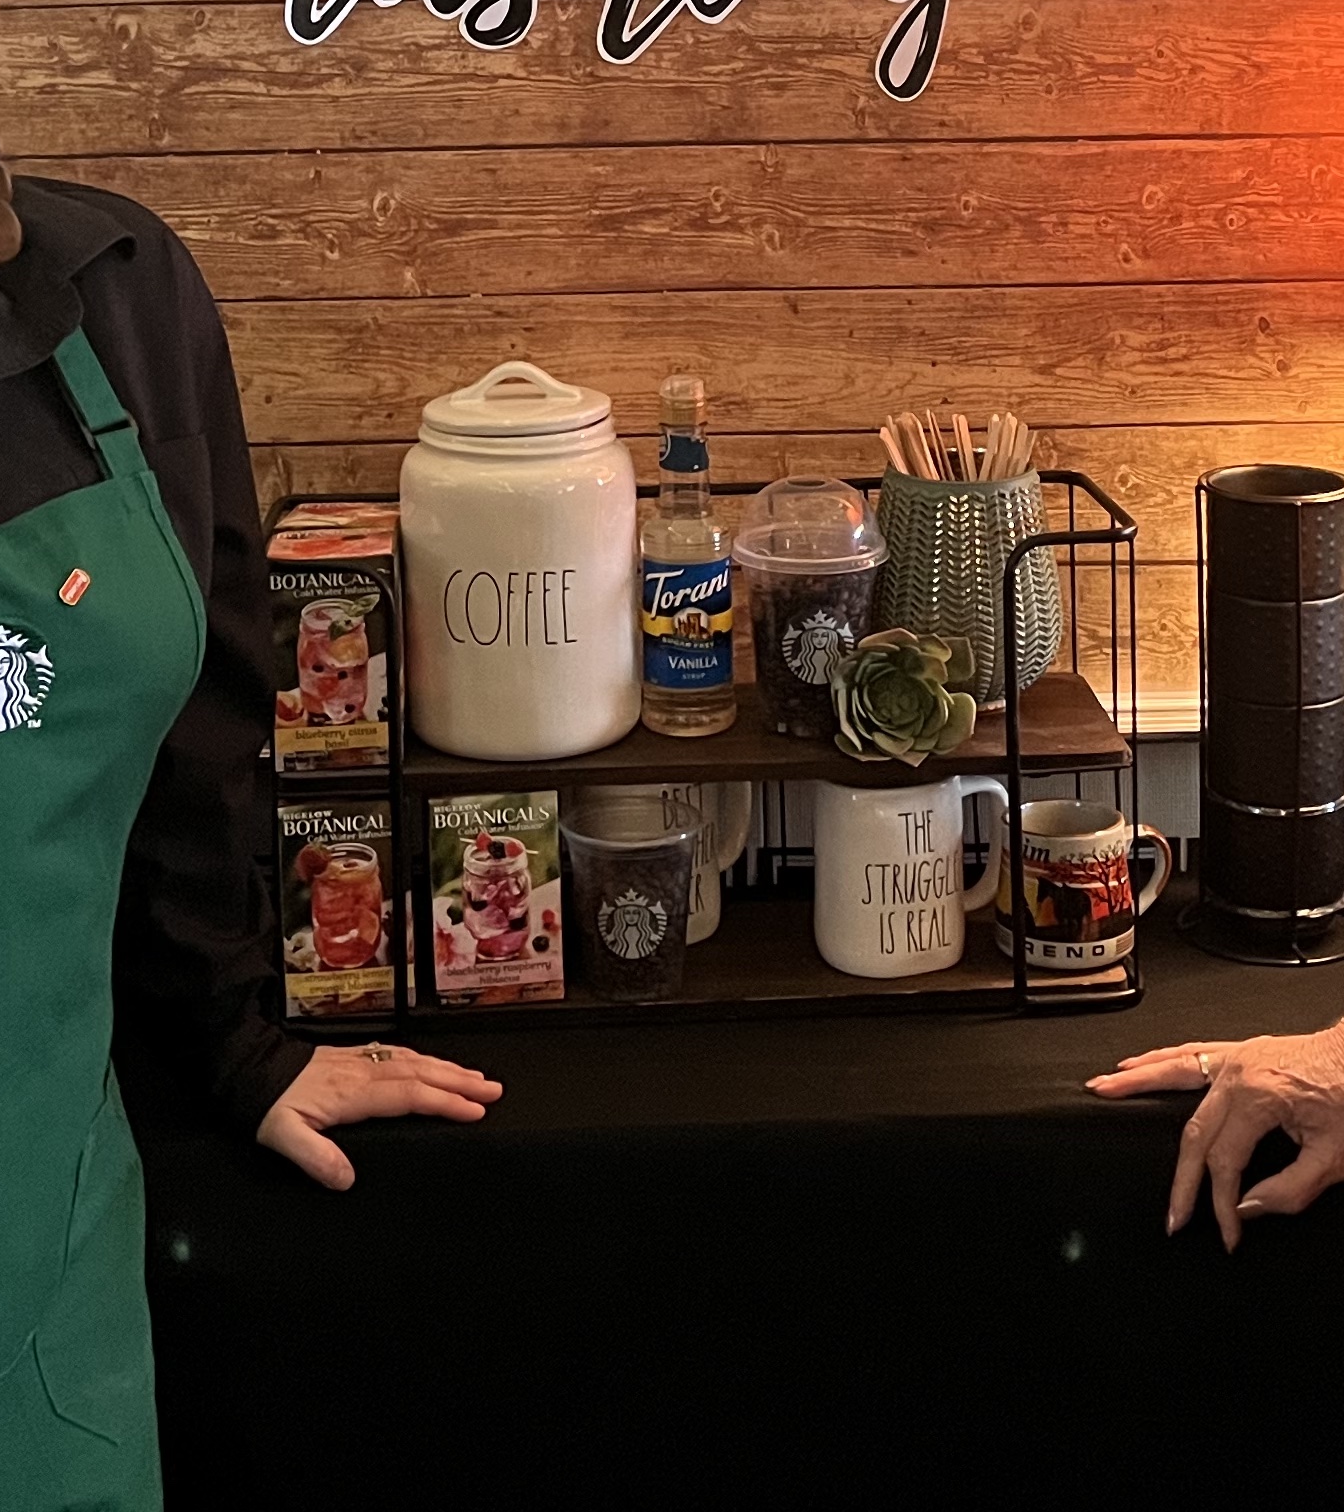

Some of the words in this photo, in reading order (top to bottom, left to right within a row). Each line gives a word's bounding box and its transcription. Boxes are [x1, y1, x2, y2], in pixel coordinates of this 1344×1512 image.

[270, 568, 390, 590] BOTANICAL
[645, 559, 730, 619] Torani
[444, 569, 578, 646] COFFEE
[668, 655, 718, 669] VANILLA
[435, 806, 550, 829] BOTANICALS
[898, 809, 935, 856] THE
[879, 911, 896, 955] IS
[907, 905, 952, 953] REAL
